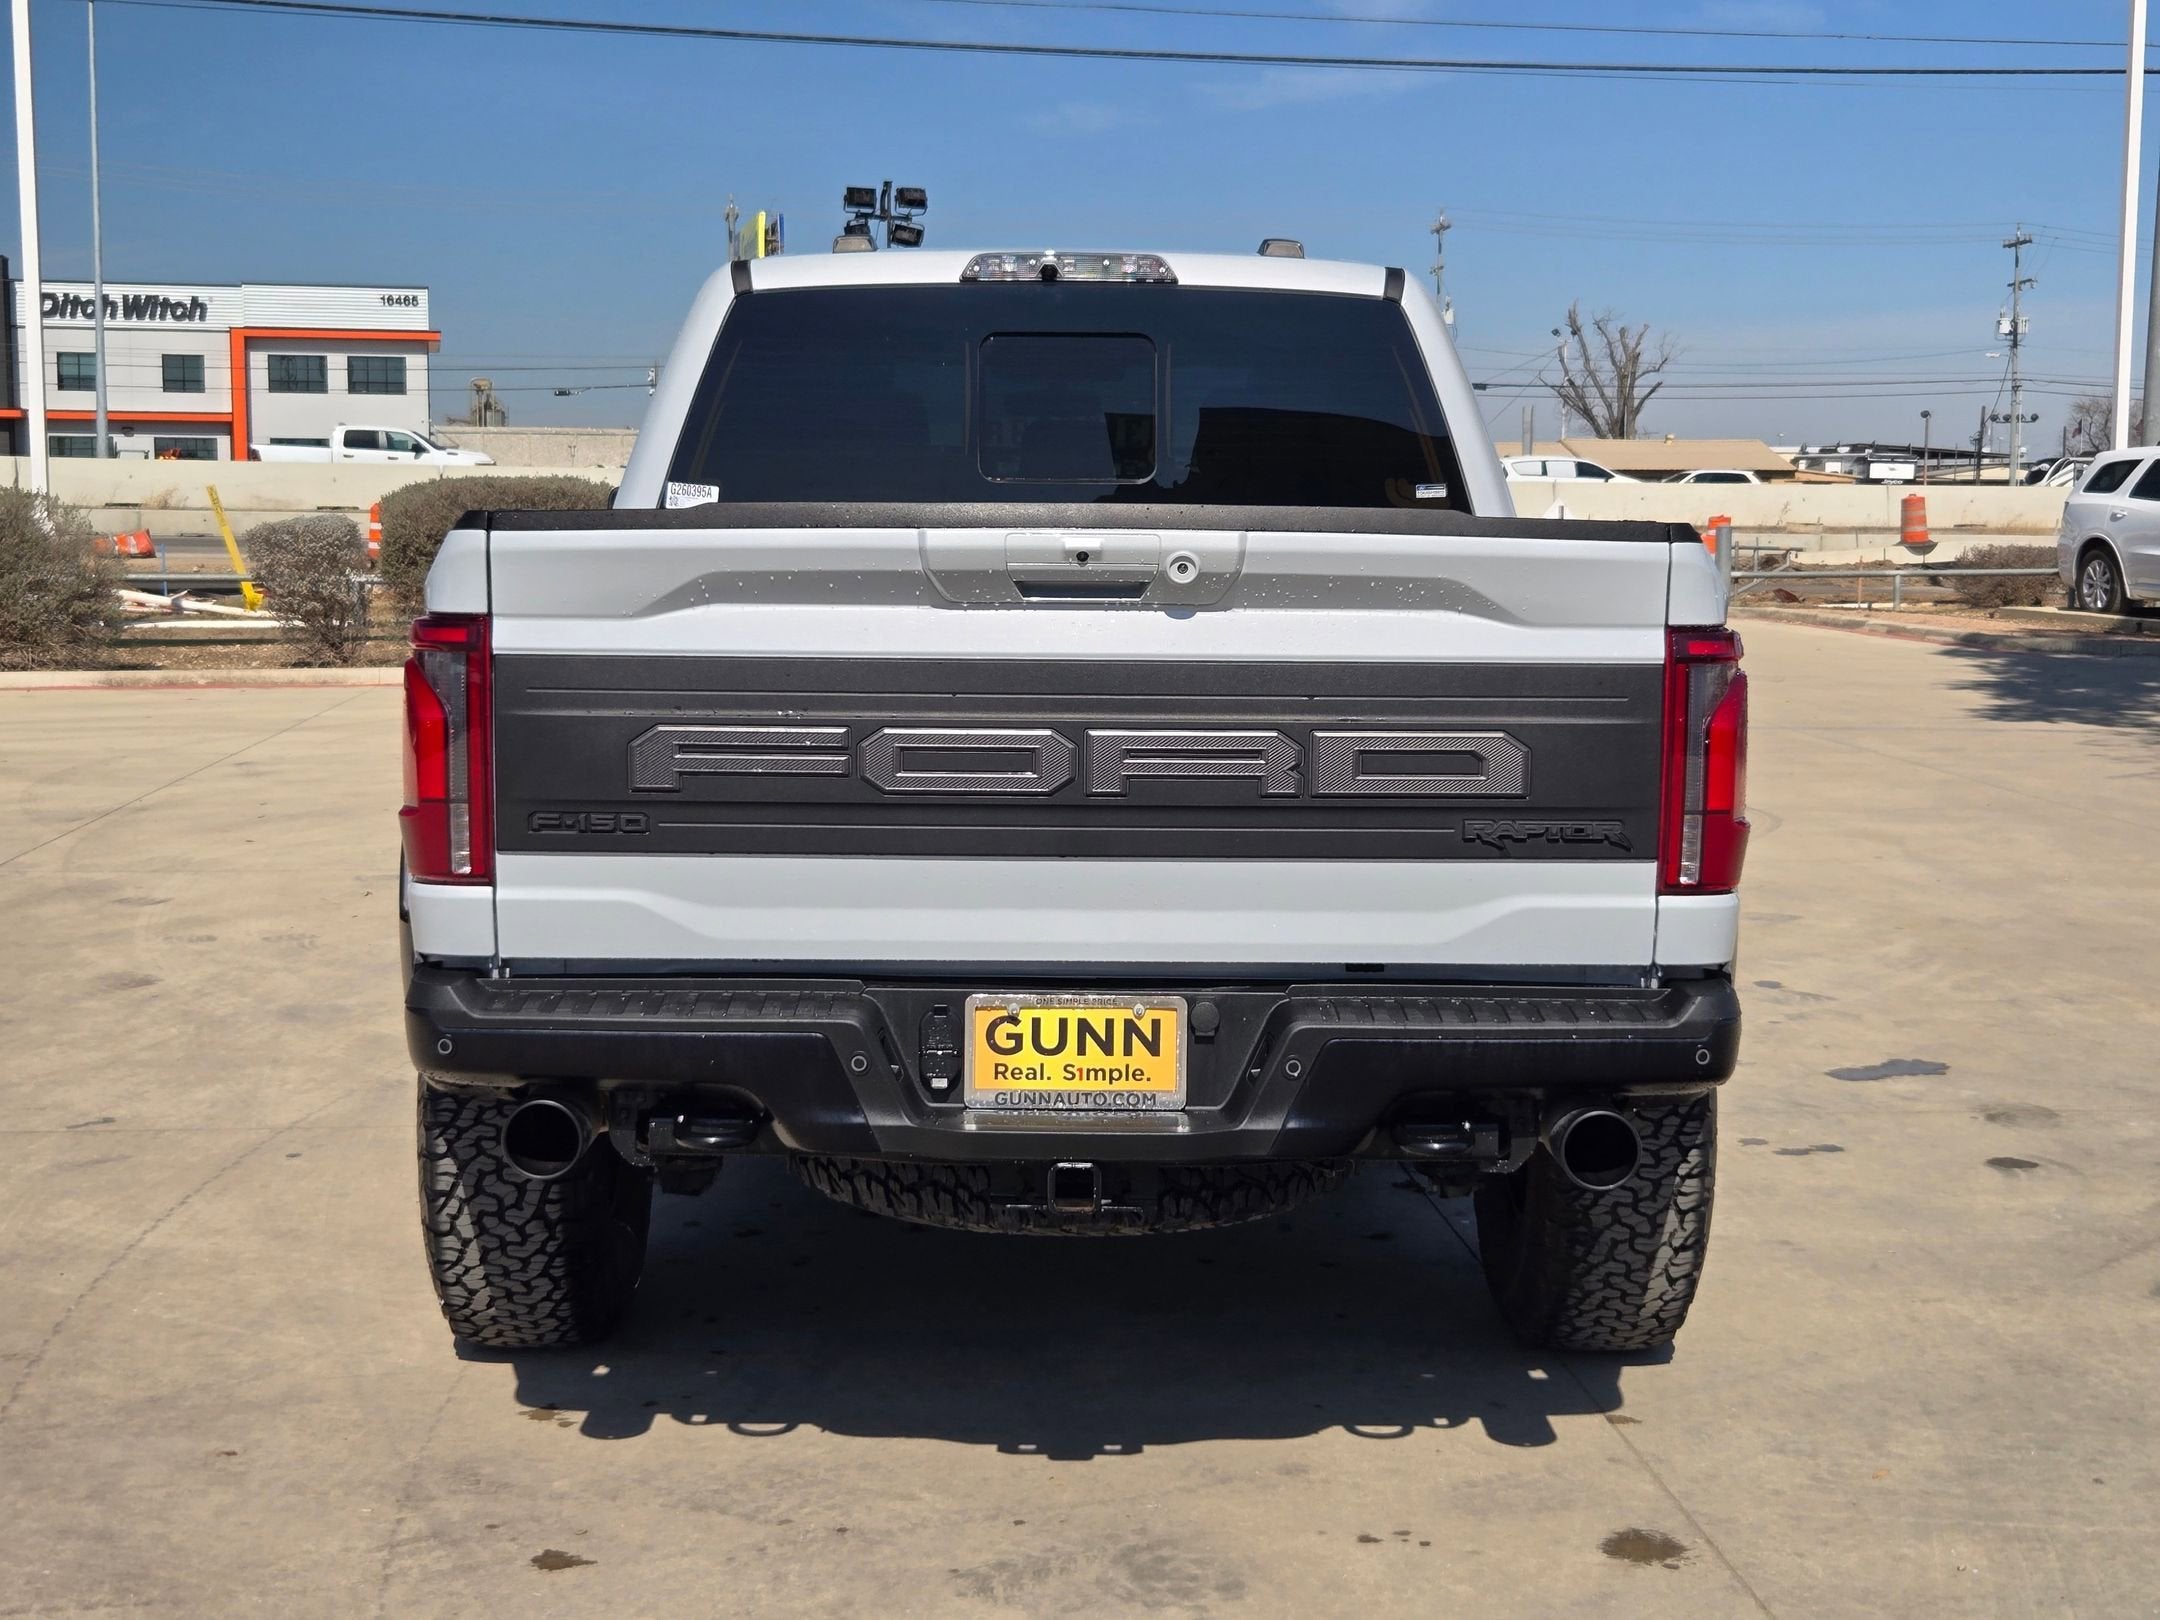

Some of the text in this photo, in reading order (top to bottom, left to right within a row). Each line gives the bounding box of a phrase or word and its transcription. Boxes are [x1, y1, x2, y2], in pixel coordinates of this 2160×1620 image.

[42, 292, 209, 322] Ditch Witch
[670, 483, 712, 498] G260395A
[628, 724, 1531, 799] FORD
[529, 811, 650, 834] F-150
[1462, 819, 1634, 854] RAPTOR
[1036, 997, 1118, 1006] ONE SIMPLE PRICE
[985, 1015, 1161, 1057] GUNN
[993, 1063, 1052, 1081] Real.
[994, 1091, 1157, 1107] GUNNAUTO.COM
